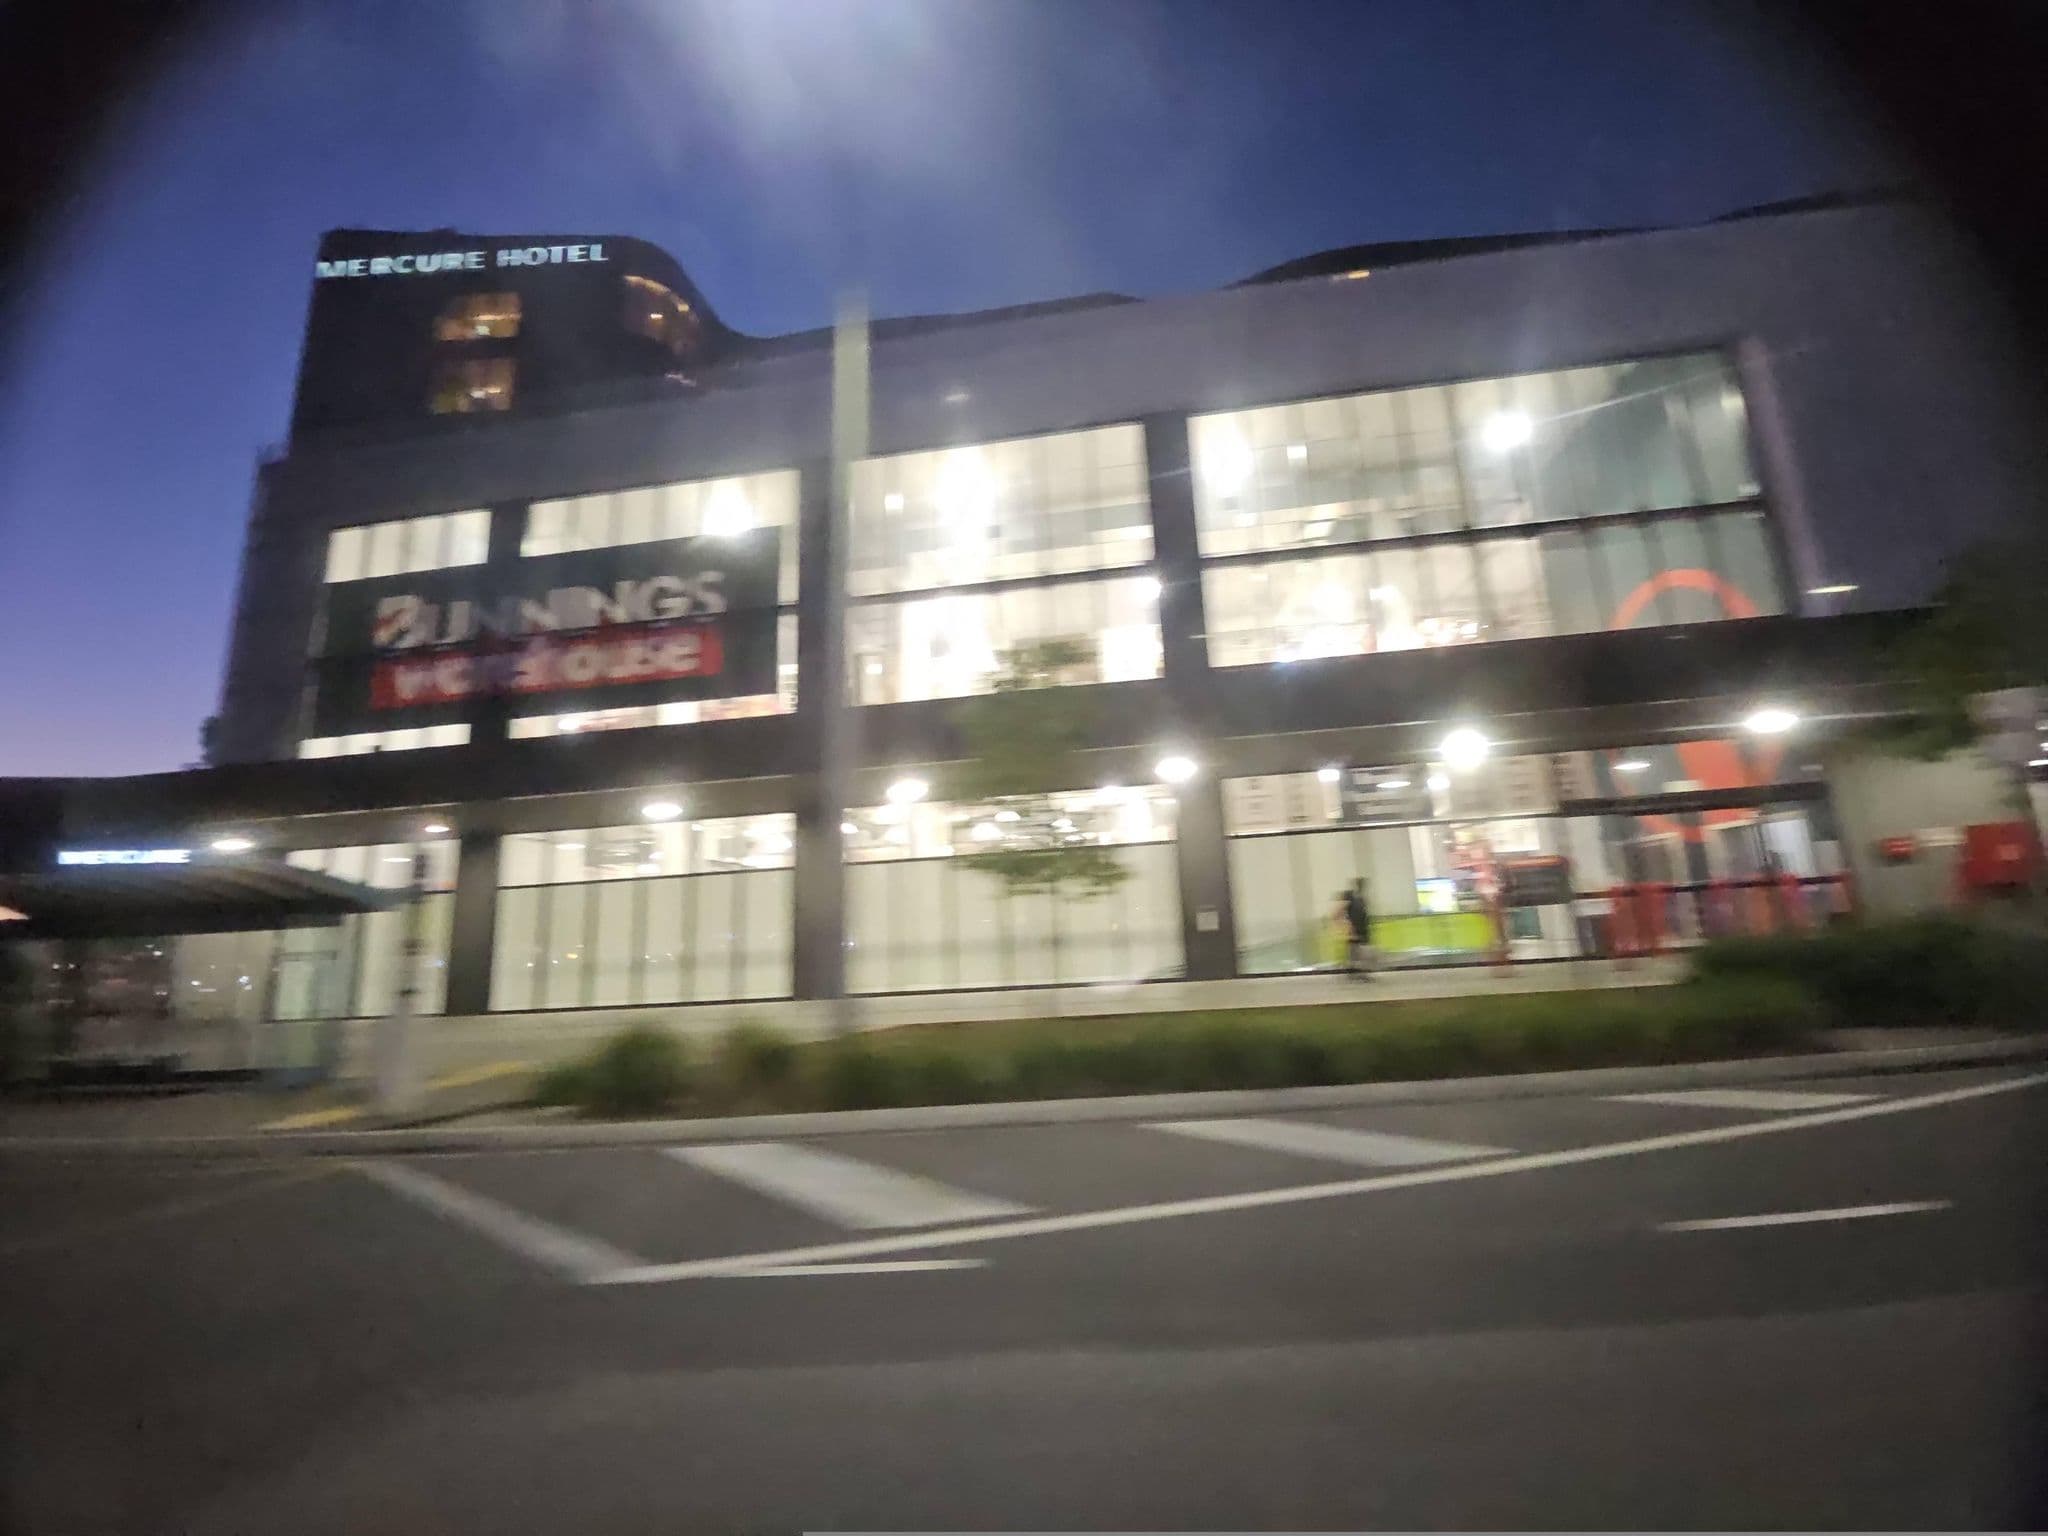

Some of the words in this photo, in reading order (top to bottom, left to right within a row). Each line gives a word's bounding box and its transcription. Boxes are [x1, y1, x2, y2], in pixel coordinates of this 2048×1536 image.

[316, 251, 487, 278] MERCURE
[496, 244, 609, 267] HOTEL
[373, 570, 727, 648] BUNNINGS
